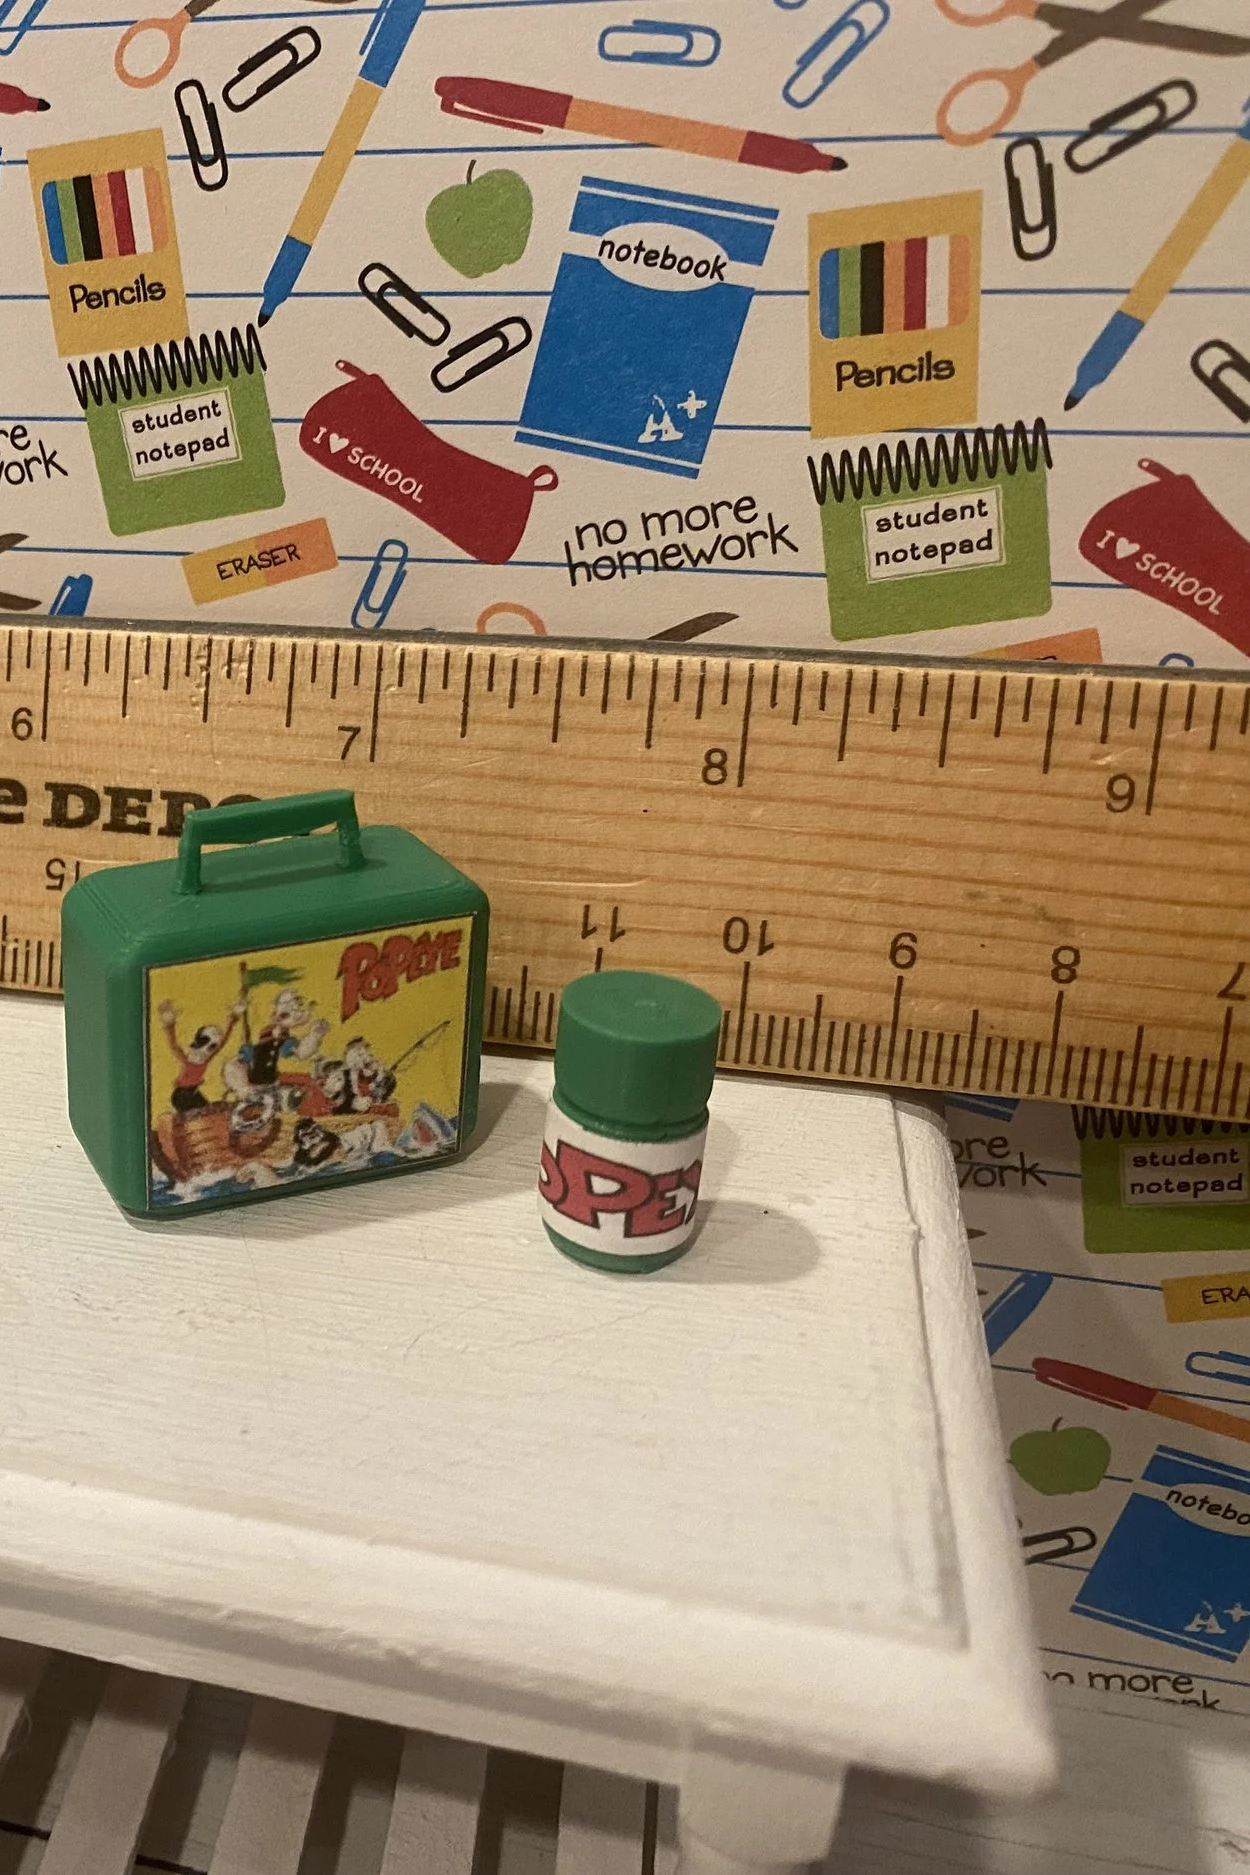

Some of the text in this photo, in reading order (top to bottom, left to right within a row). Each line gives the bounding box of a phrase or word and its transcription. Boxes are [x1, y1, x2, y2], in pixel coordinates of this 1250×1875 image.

[597, 237, 727, 282] notebook
[68, 274, 167, 313] Pencils
[835, 351, 956, 392] Pencils
[131, 399, 222, 433] student
[134, 428, 230, 466] notepad
[312, 426, 425, 503] I SCHOOL
[575, 494, 759, 551] no more
[874, 499, 990, 534] student
[216, 544, 301, 581] ERASER
[563, 513, 800, 587] homework
[874, 529, 995, 567] notepad
[1094, 529, 1227, 617] I SCHOOL
[10, 706, 34, 741] 6
[337, 725, 362, 761] 7
[701, 747, 729, 786] 8
[42, 781, 264, 838] DEP
[1104, 773, 1136, 814] 9
[579, 903, 626, 943] 11
[722, 916, 775, 956] 10
[888, 931, 919, 971] 9
[1051, 945, 1082, 984] 8
[335, 928, 463, 1024] POPEYE
[1217, 960, 1247, 1000] 7
[950, 1136, 1011, 1160] ore
[1132, 1147, 1242, 1168] student
[1129, 1172, 1244, 1198] notepad
[1201, 1285, 1250, 1305] ERA
[1165, 1489, 1250, 1526] notebo
[1087, 1671, 1194, 1695] more
